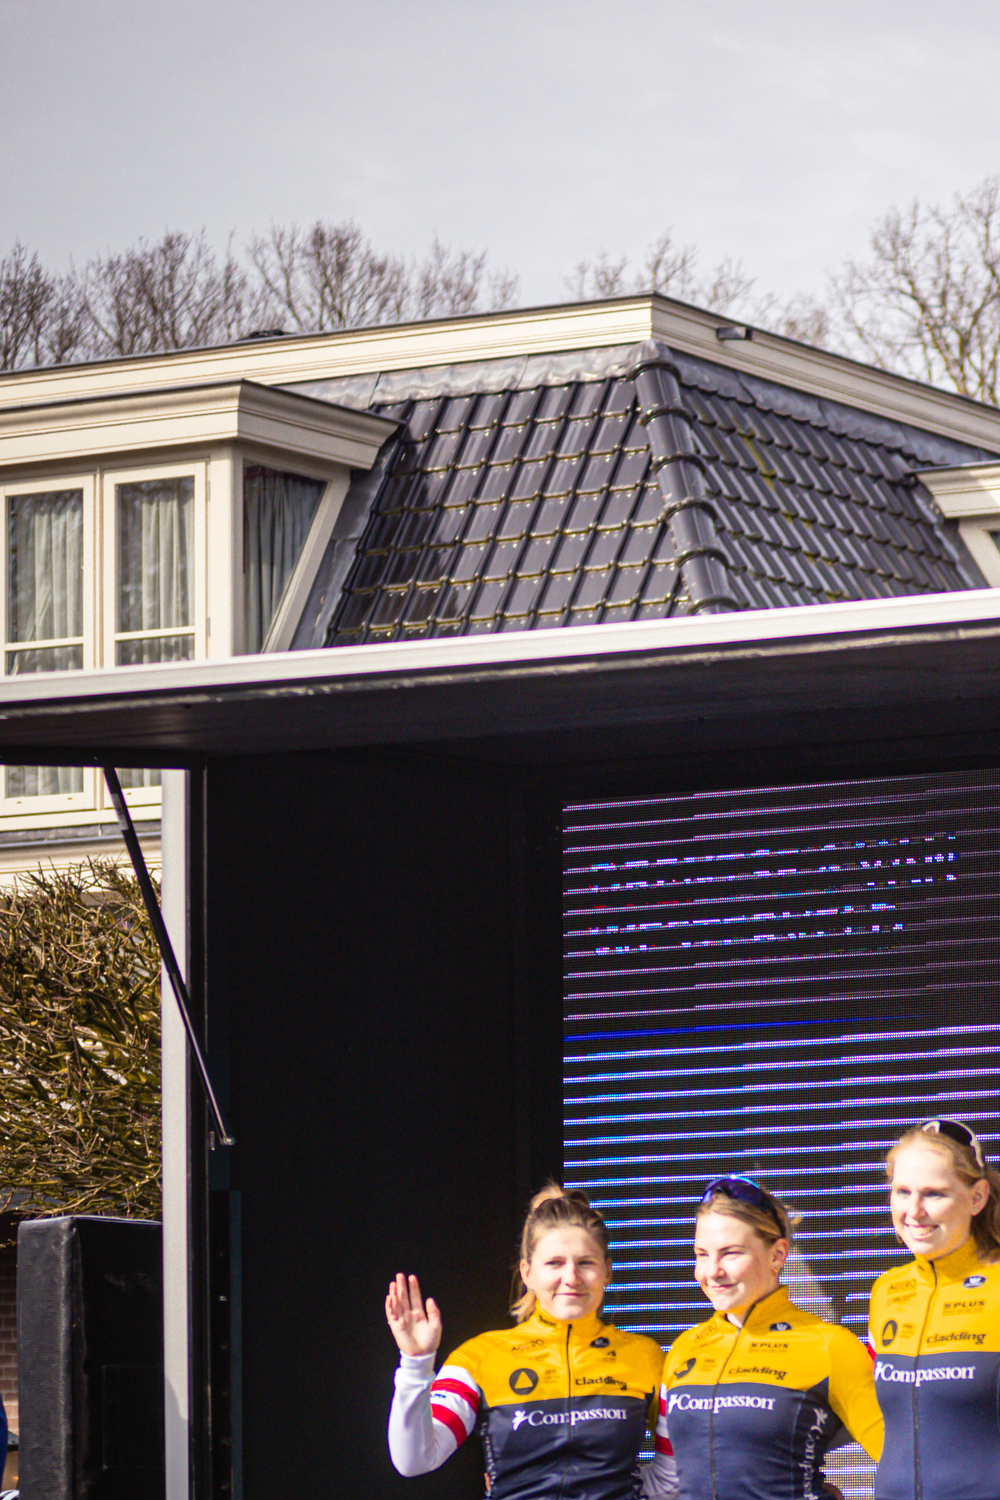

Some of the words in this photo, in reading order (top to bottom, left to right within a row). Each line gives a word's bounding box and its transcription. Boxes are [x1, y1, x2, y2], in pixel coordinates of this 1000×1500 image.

[881, 1363, 976, 1387] Compassion
[677, 1393, 776, 1414] Compassion
[527, 1407, 628, 1427] Compassion
